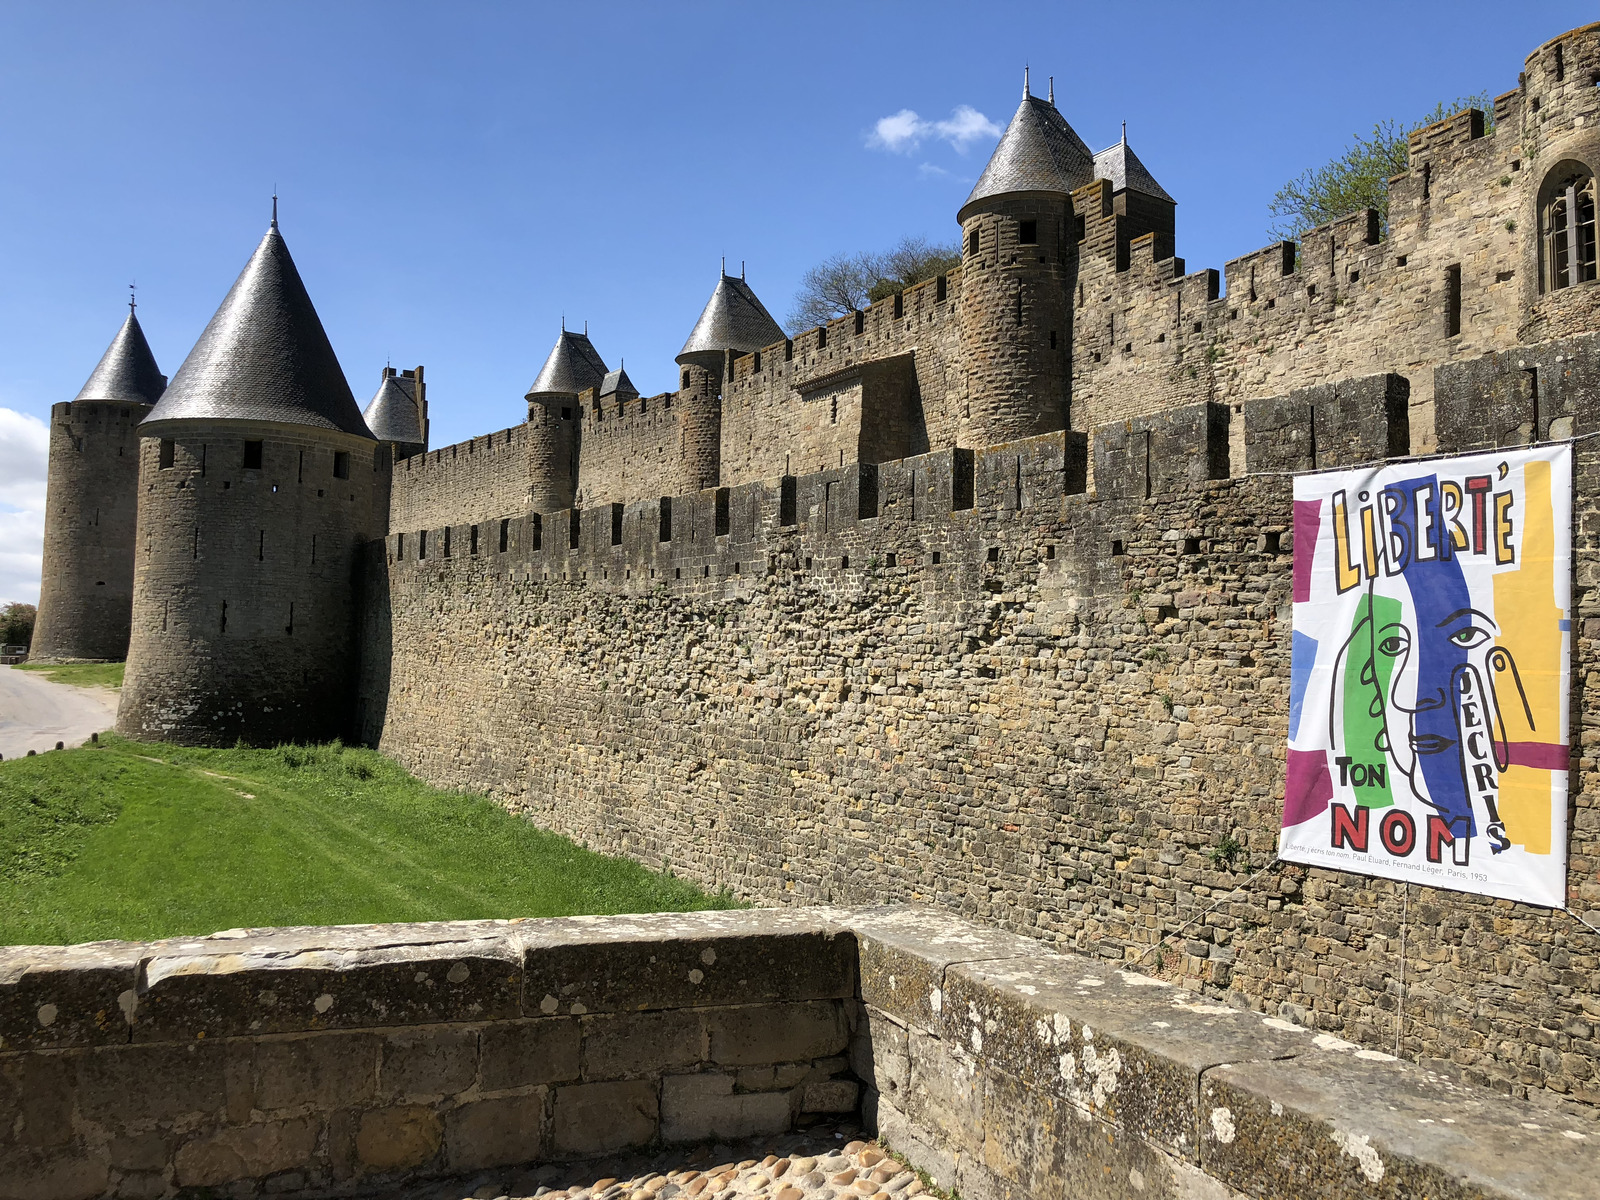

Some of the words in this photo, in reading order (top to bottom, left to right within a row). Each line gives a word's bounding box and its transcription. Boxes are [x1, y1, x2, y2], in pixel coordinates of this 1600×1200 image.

[1336, 756, 1386, 790] TON
[1330, 801, 1471, 867] NOM
[1285, 843, 1306, 853] Liberté,
[1307, 846, 1325, 855] j'écris
[1325, 849, 1336, 857] ton
[1352, 853, 1367, 862] Paul
[1368, 855, 1391, 867] Éluard,
[1392, 859, 1421, 871] Fernand
[1422, 864, 1444, 876] Léger,
[1447, 868, 1468, 880] Paris,
[1470, 872, 1488, 882] 1953
